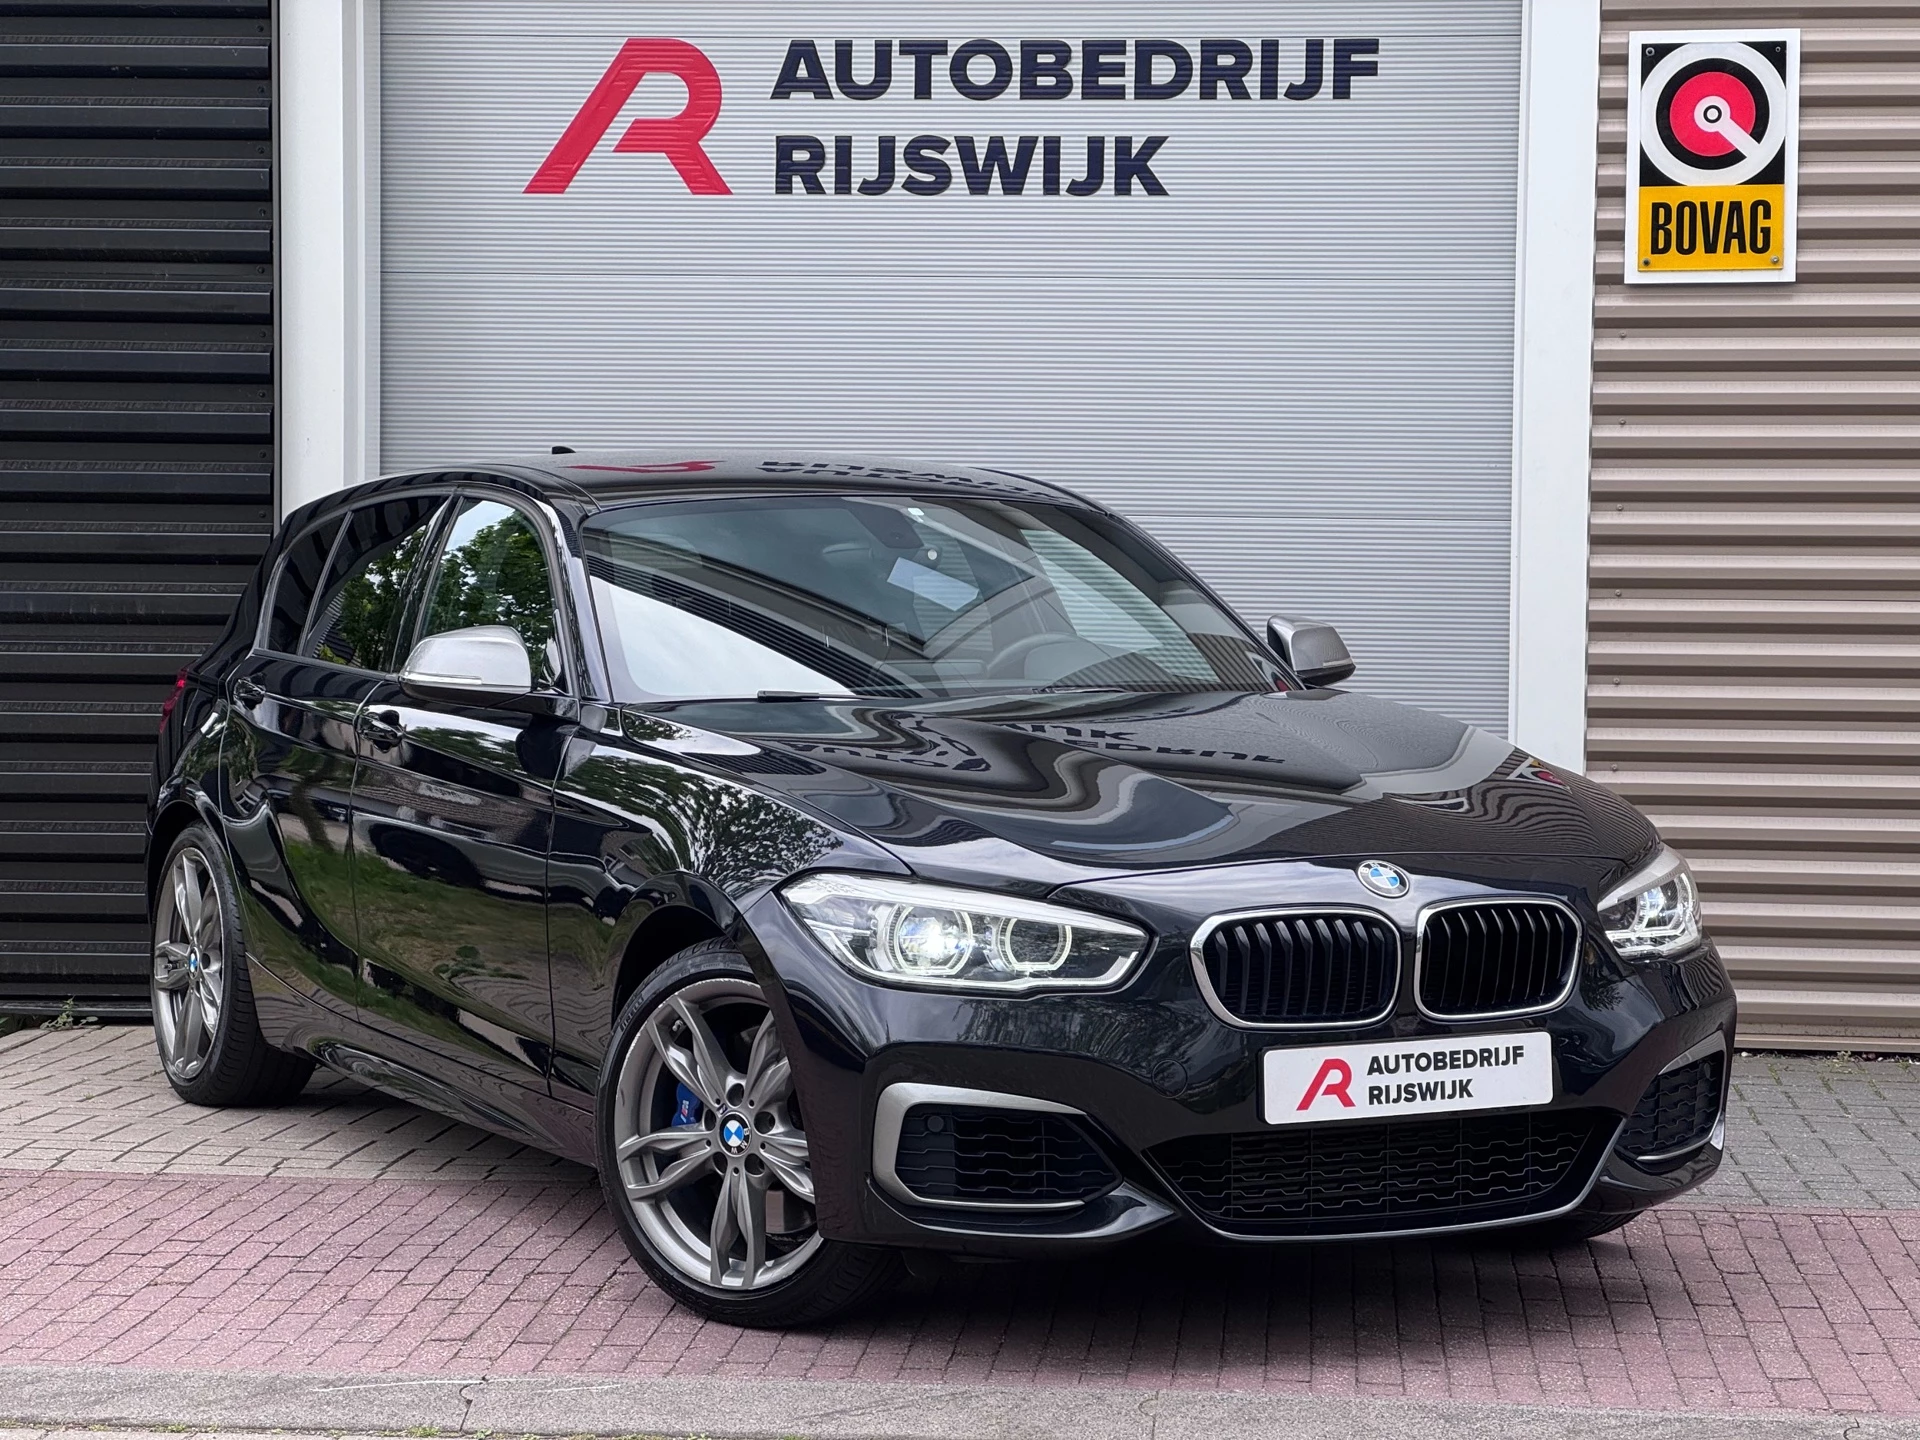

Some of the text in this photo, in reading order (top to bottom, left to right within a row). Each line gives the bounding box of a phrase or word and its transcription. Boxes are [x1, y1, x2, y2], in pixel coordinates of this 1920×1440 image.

[770, 38, 1380, 101] AUTOBEDRIJF
[775, 135, 1171, 197] RIJSWIJK
[1651, 199, 1772, 256] BOVAG
[1366, 1045, 1525, 1076] AUTOBEDRIJF
[1368, 1078, 1474, 1106] RIJSWIJK
